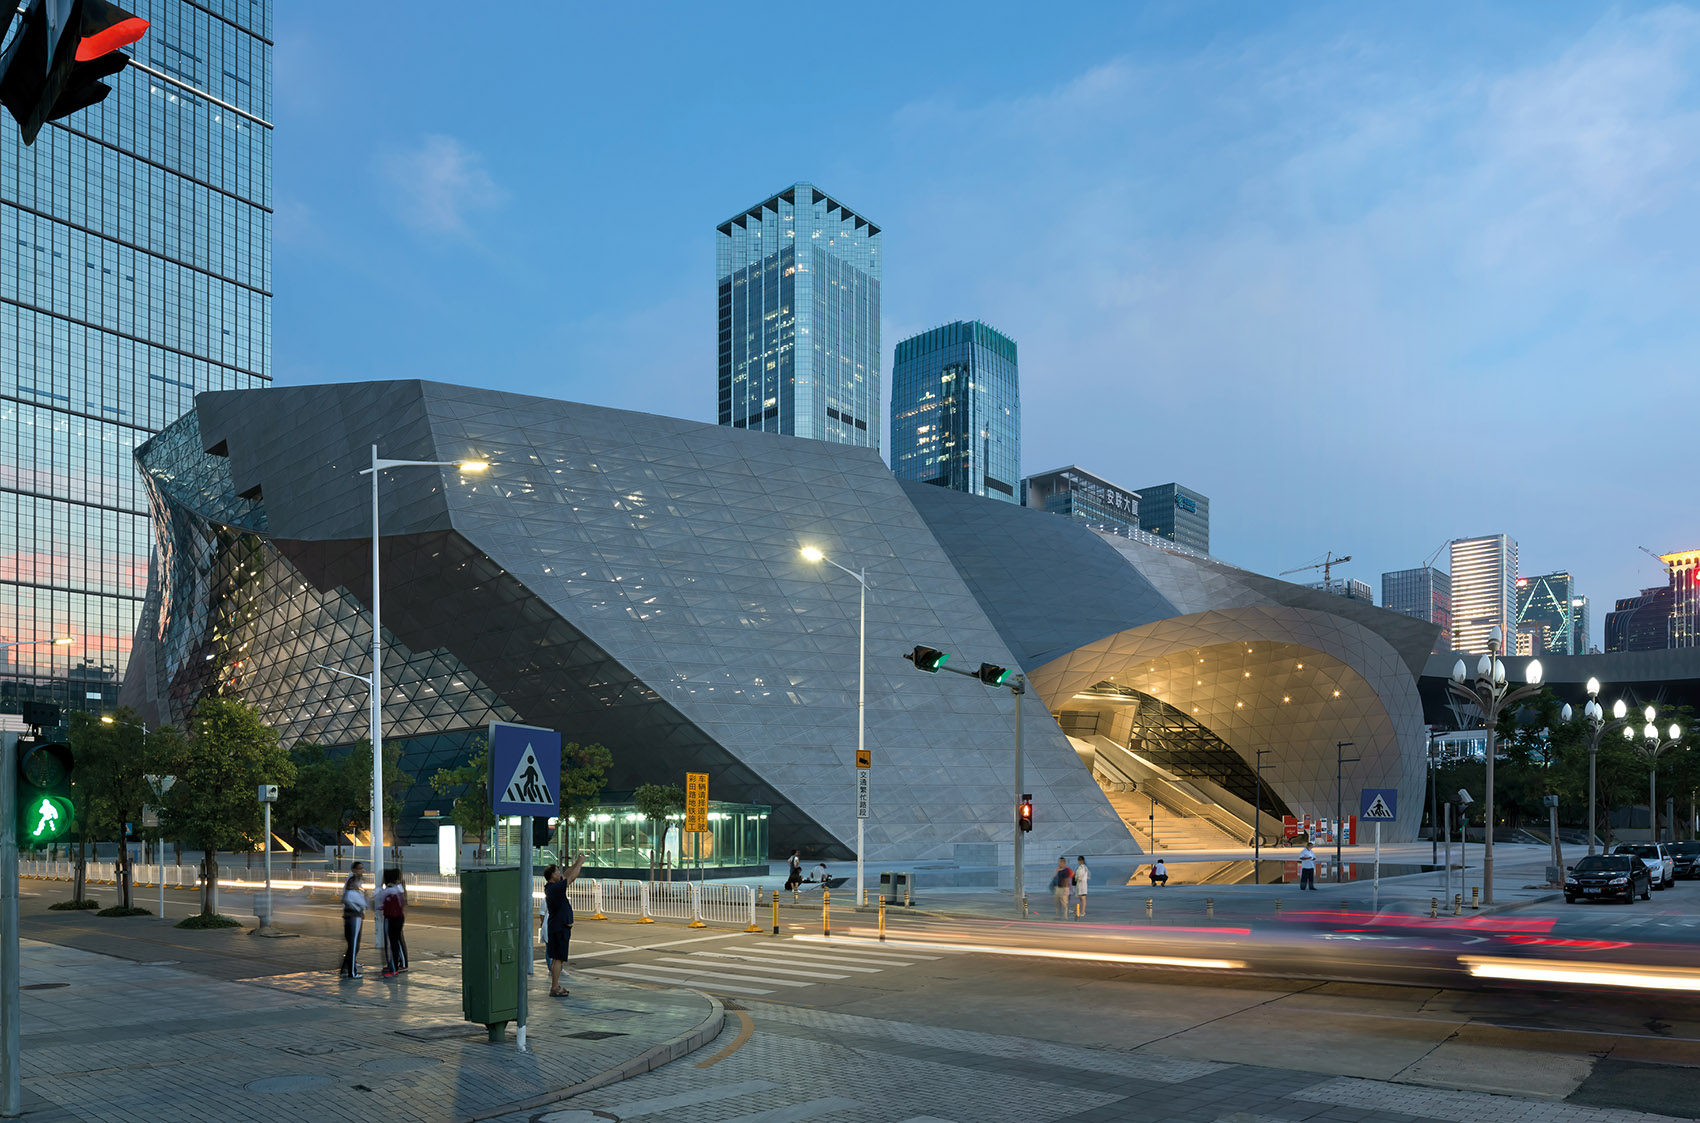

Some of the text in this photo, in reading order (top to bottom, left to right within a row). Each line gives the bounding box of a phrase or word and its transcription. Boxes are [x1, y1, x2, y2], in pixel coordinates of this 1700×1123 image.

[1106, 489, 1138, 516] 安联大厦
[688, 775, 696, 830] 彩田路地铁施工
[698, 775, 706, 830] 车辆请择道行驶
[859, 771, 867, 816] 交通繁忙路段
